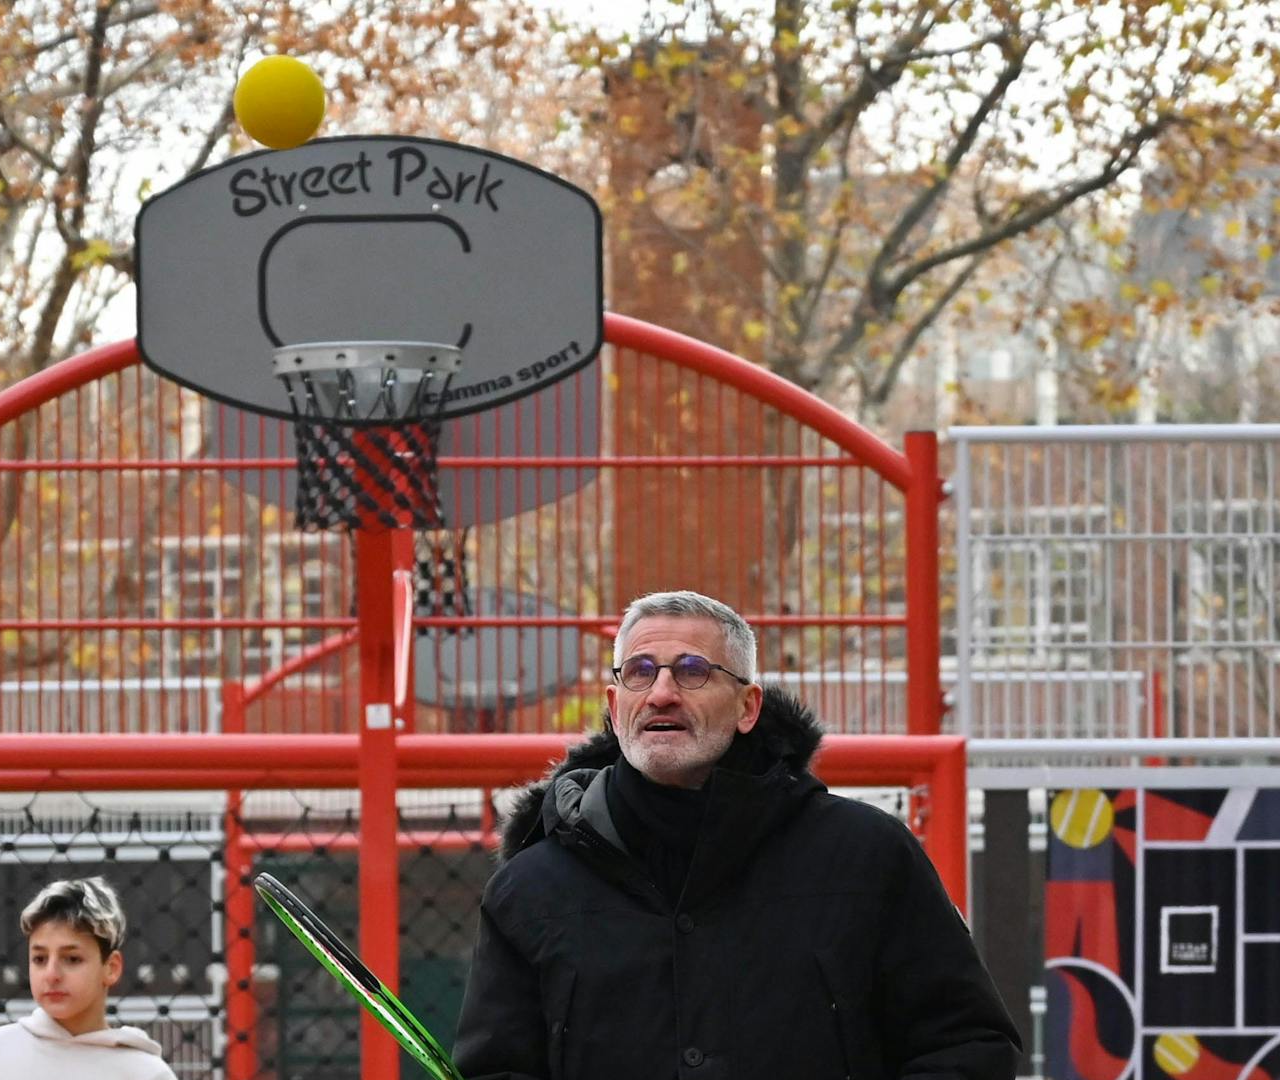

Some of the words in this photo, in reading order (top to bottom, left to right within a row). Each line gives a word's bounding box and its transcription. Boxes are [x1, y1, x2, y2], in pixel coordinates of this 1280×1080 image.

[229, 151, 372, 217] Street
[387, 146, 504, 212] Park
[517, 341, 582, 380] sport
